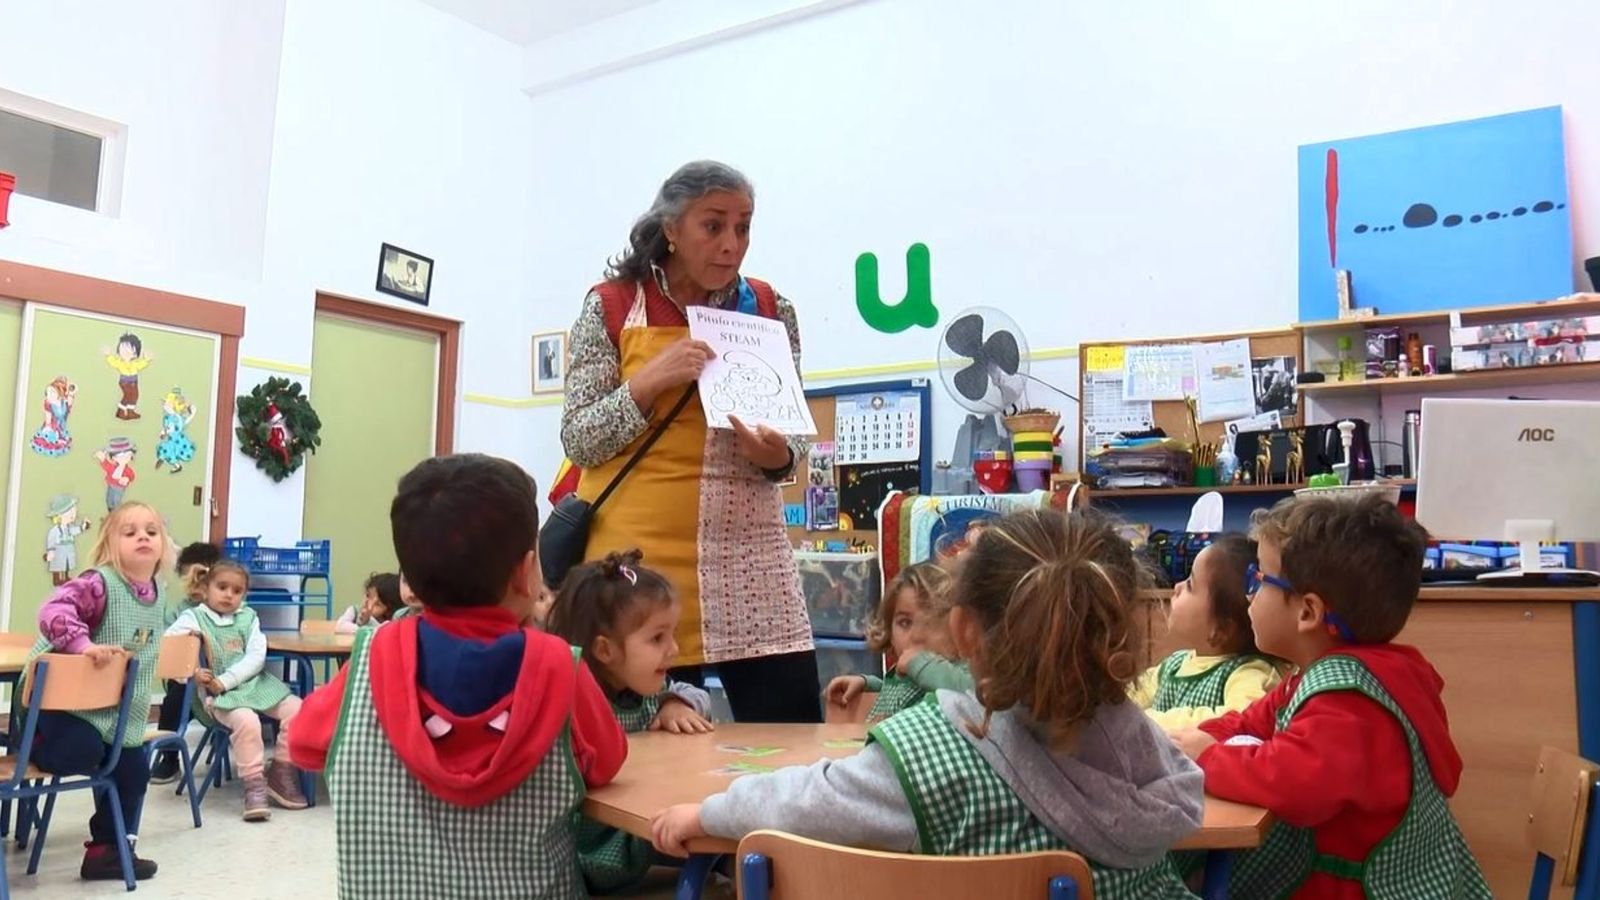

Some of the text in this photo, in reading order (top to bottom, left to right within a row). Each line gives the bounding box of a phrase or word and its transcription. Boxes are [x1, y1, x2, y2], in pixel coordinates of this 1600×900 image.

[696, 311, 729, 326] Pitufo
[719, 331, 761, 348] STEAM
[1518, 428, 1555, 442] AOC
